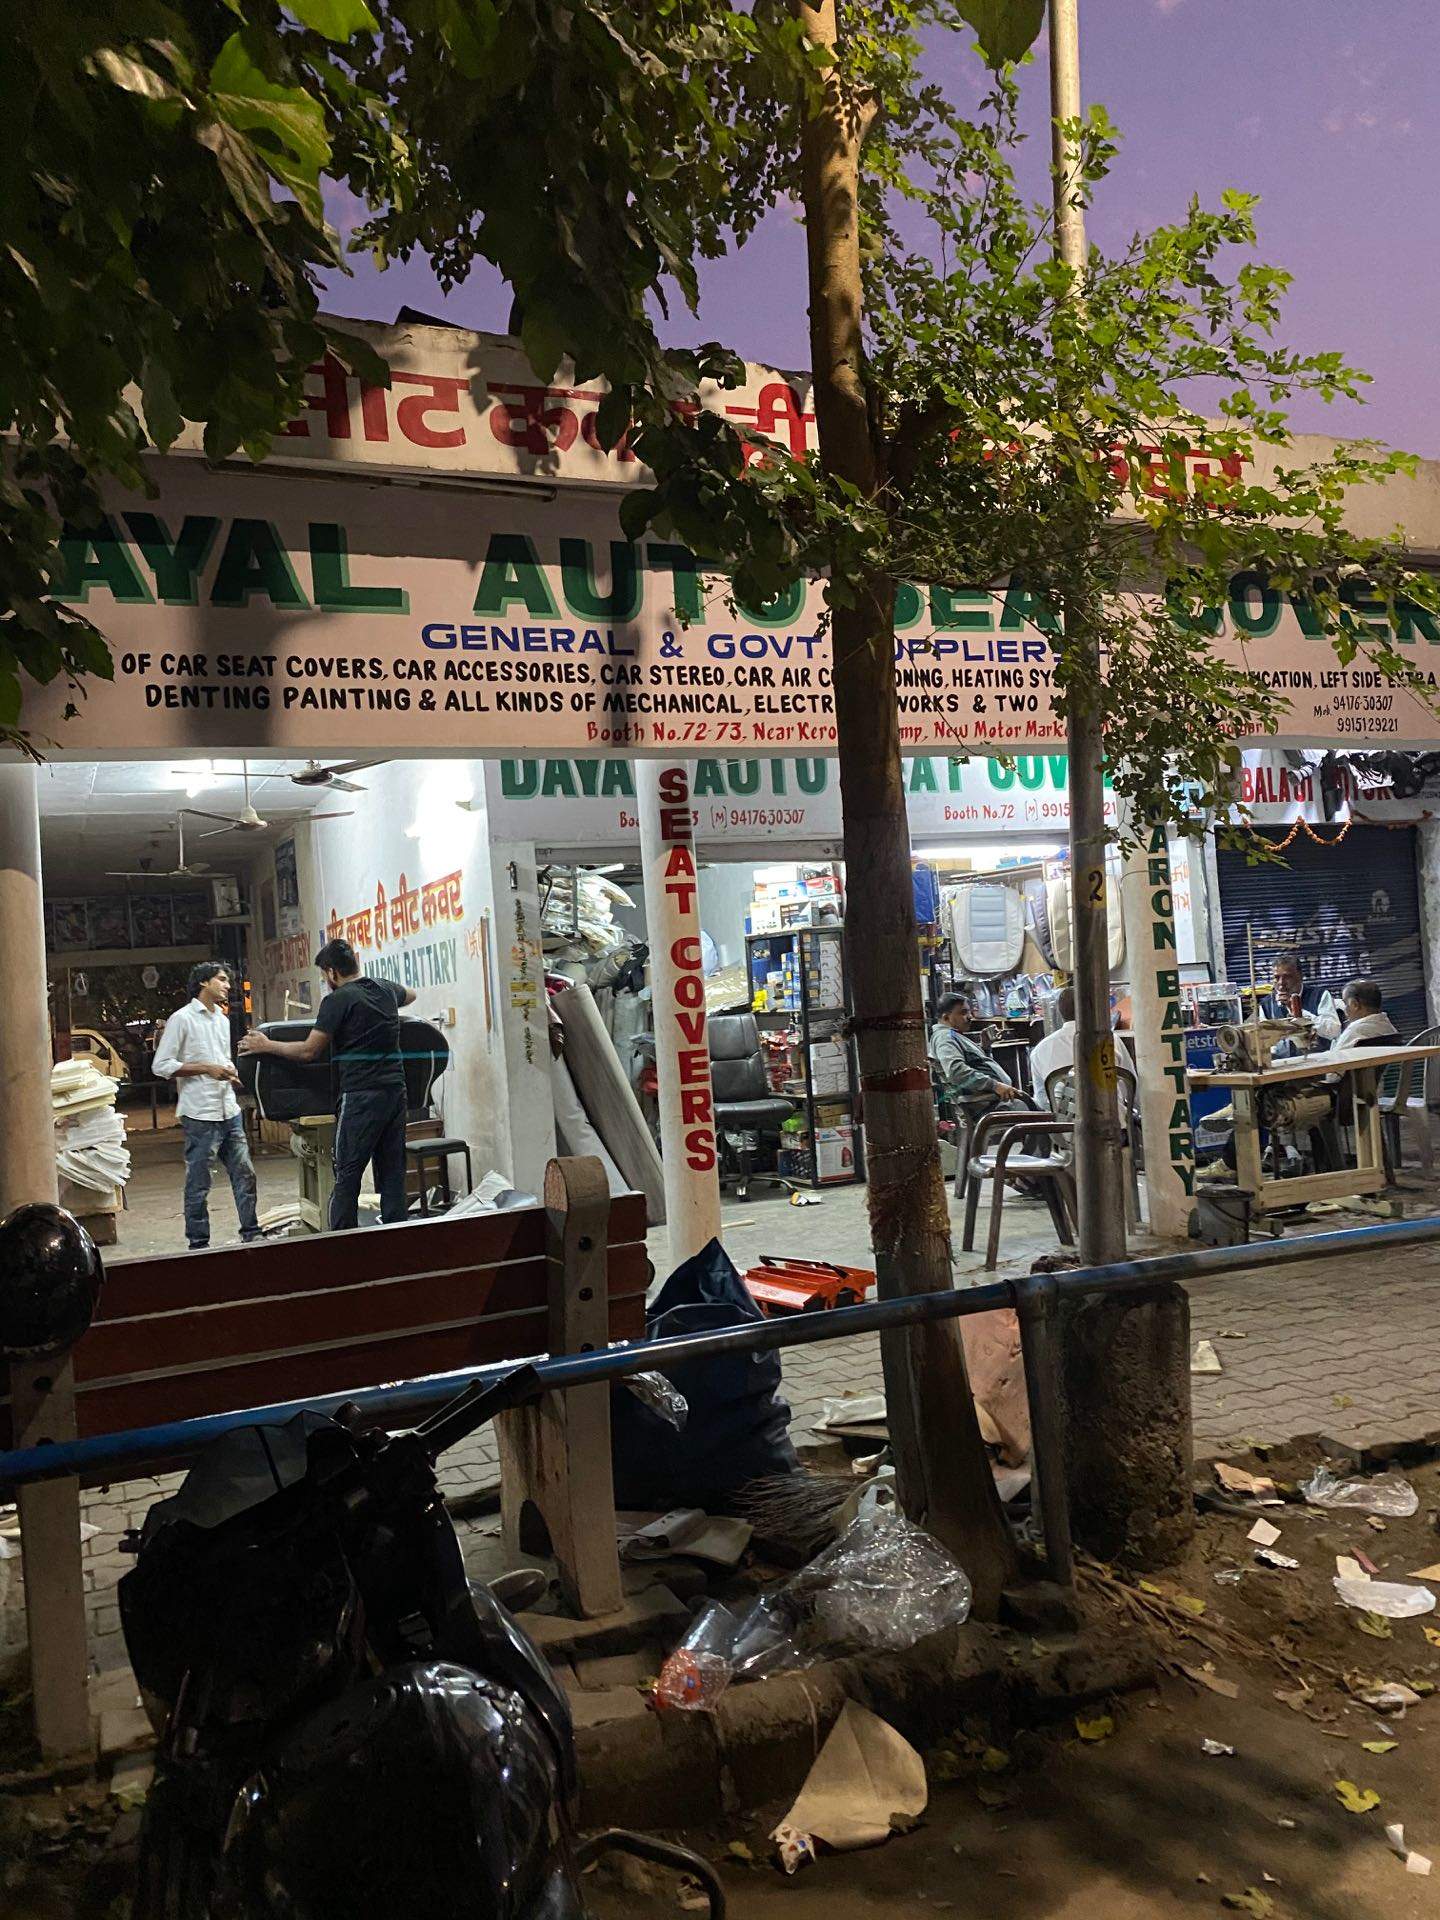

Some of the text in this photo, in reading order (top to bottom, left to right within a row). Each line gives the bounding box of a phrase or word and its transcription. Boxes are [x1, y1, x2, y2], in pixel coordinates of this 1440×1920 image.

[50, 511, 410, 616] AYAL
[421, 623, 1065, 664] GENERAL & GOVT. PPLIER
[121, 653, 151, 675] OF
[160, 653, 208, 677] CAR
[216, 654, 277, 677] SEAT
[286, 655, 389, 682] COVERS,
[392, 658, 437, 682] CAR
[444, 659, 596, 686] ACCESSORIES,
[601, 664, 643, 686] CAR
[650, 665, 733, 688] STEREO,
[734, 666, 776, 689] CAR
[782, 667, 812, 688] AIR
[952, 669, 1024, 689] HEATING
[1320, 671, 1349, 689] LEFT
[1352, 671, 1382, 689] SIDE
[145, 684, 271, 710] DENTING
[283, 686, 411, 711] PAINTING
[418, 688, 436, 712] &
[444, 690, 490, 713] ALL
[496, 690, 564, 713] KINDS
[570, 691, 597, 713] OF
[602, 692, 750, 717] MECHANICAL,
[754, 694, 834, 715] ELECTR
[972, 694, 987, 713] &
[998, 694, 1039, 713] TWO
[587, 721, 645, 741] Booth
[753, 722, 794, 742] Near
[798, 723, 837, 742] Kero
[933, 721, 968, 740] New
[974, 720, 1021, 740] Motor
[1025, 720, 1068, 739] Mark
[1337, 717, 1399, 733] 9915129221
[500, 759, 637, 800] DAYA
[693, 758, 829, 797] AUTO
[944, 804, 979, 821] Booth
[659, 767, 699, 914] SEAT
[421, 868, 464, 928] कवर
[1088, 870, 1103, 901] 2
[403, 937, 459, 989] BATTARY
[671, 936, 717, 1172] COVERS
[1156, 969, 1196, 1197] BATTARY
